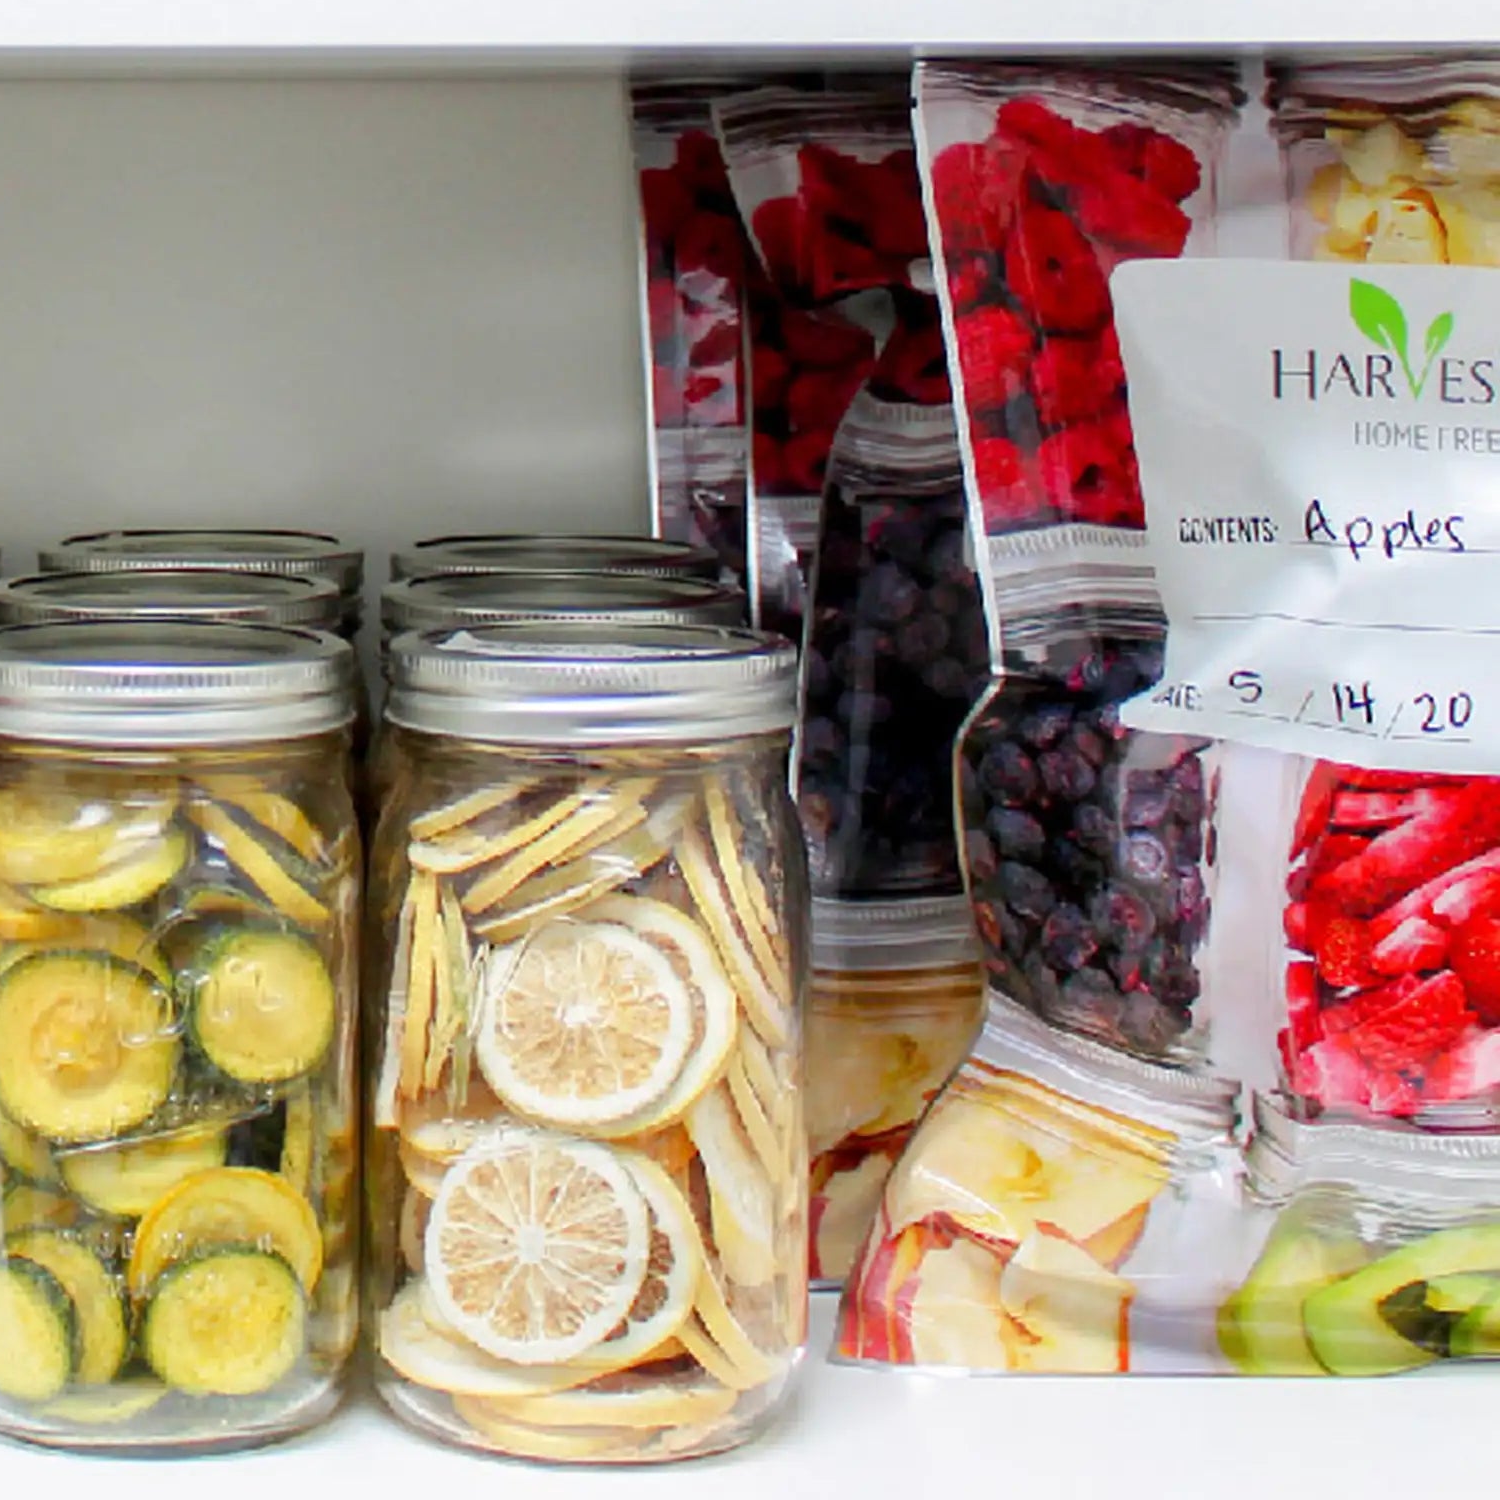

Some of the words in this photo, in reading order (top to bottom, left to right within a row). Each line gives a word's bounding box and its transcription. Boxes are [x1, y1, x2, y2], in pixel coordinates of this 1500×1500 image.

[1353, 421, 1428, 450] HOME
[1179, 516, 1278, 543] CONTENTS:
[1304, 499, 1465, 560] Apples
[1157, 684, 1204, 712] ATE:
